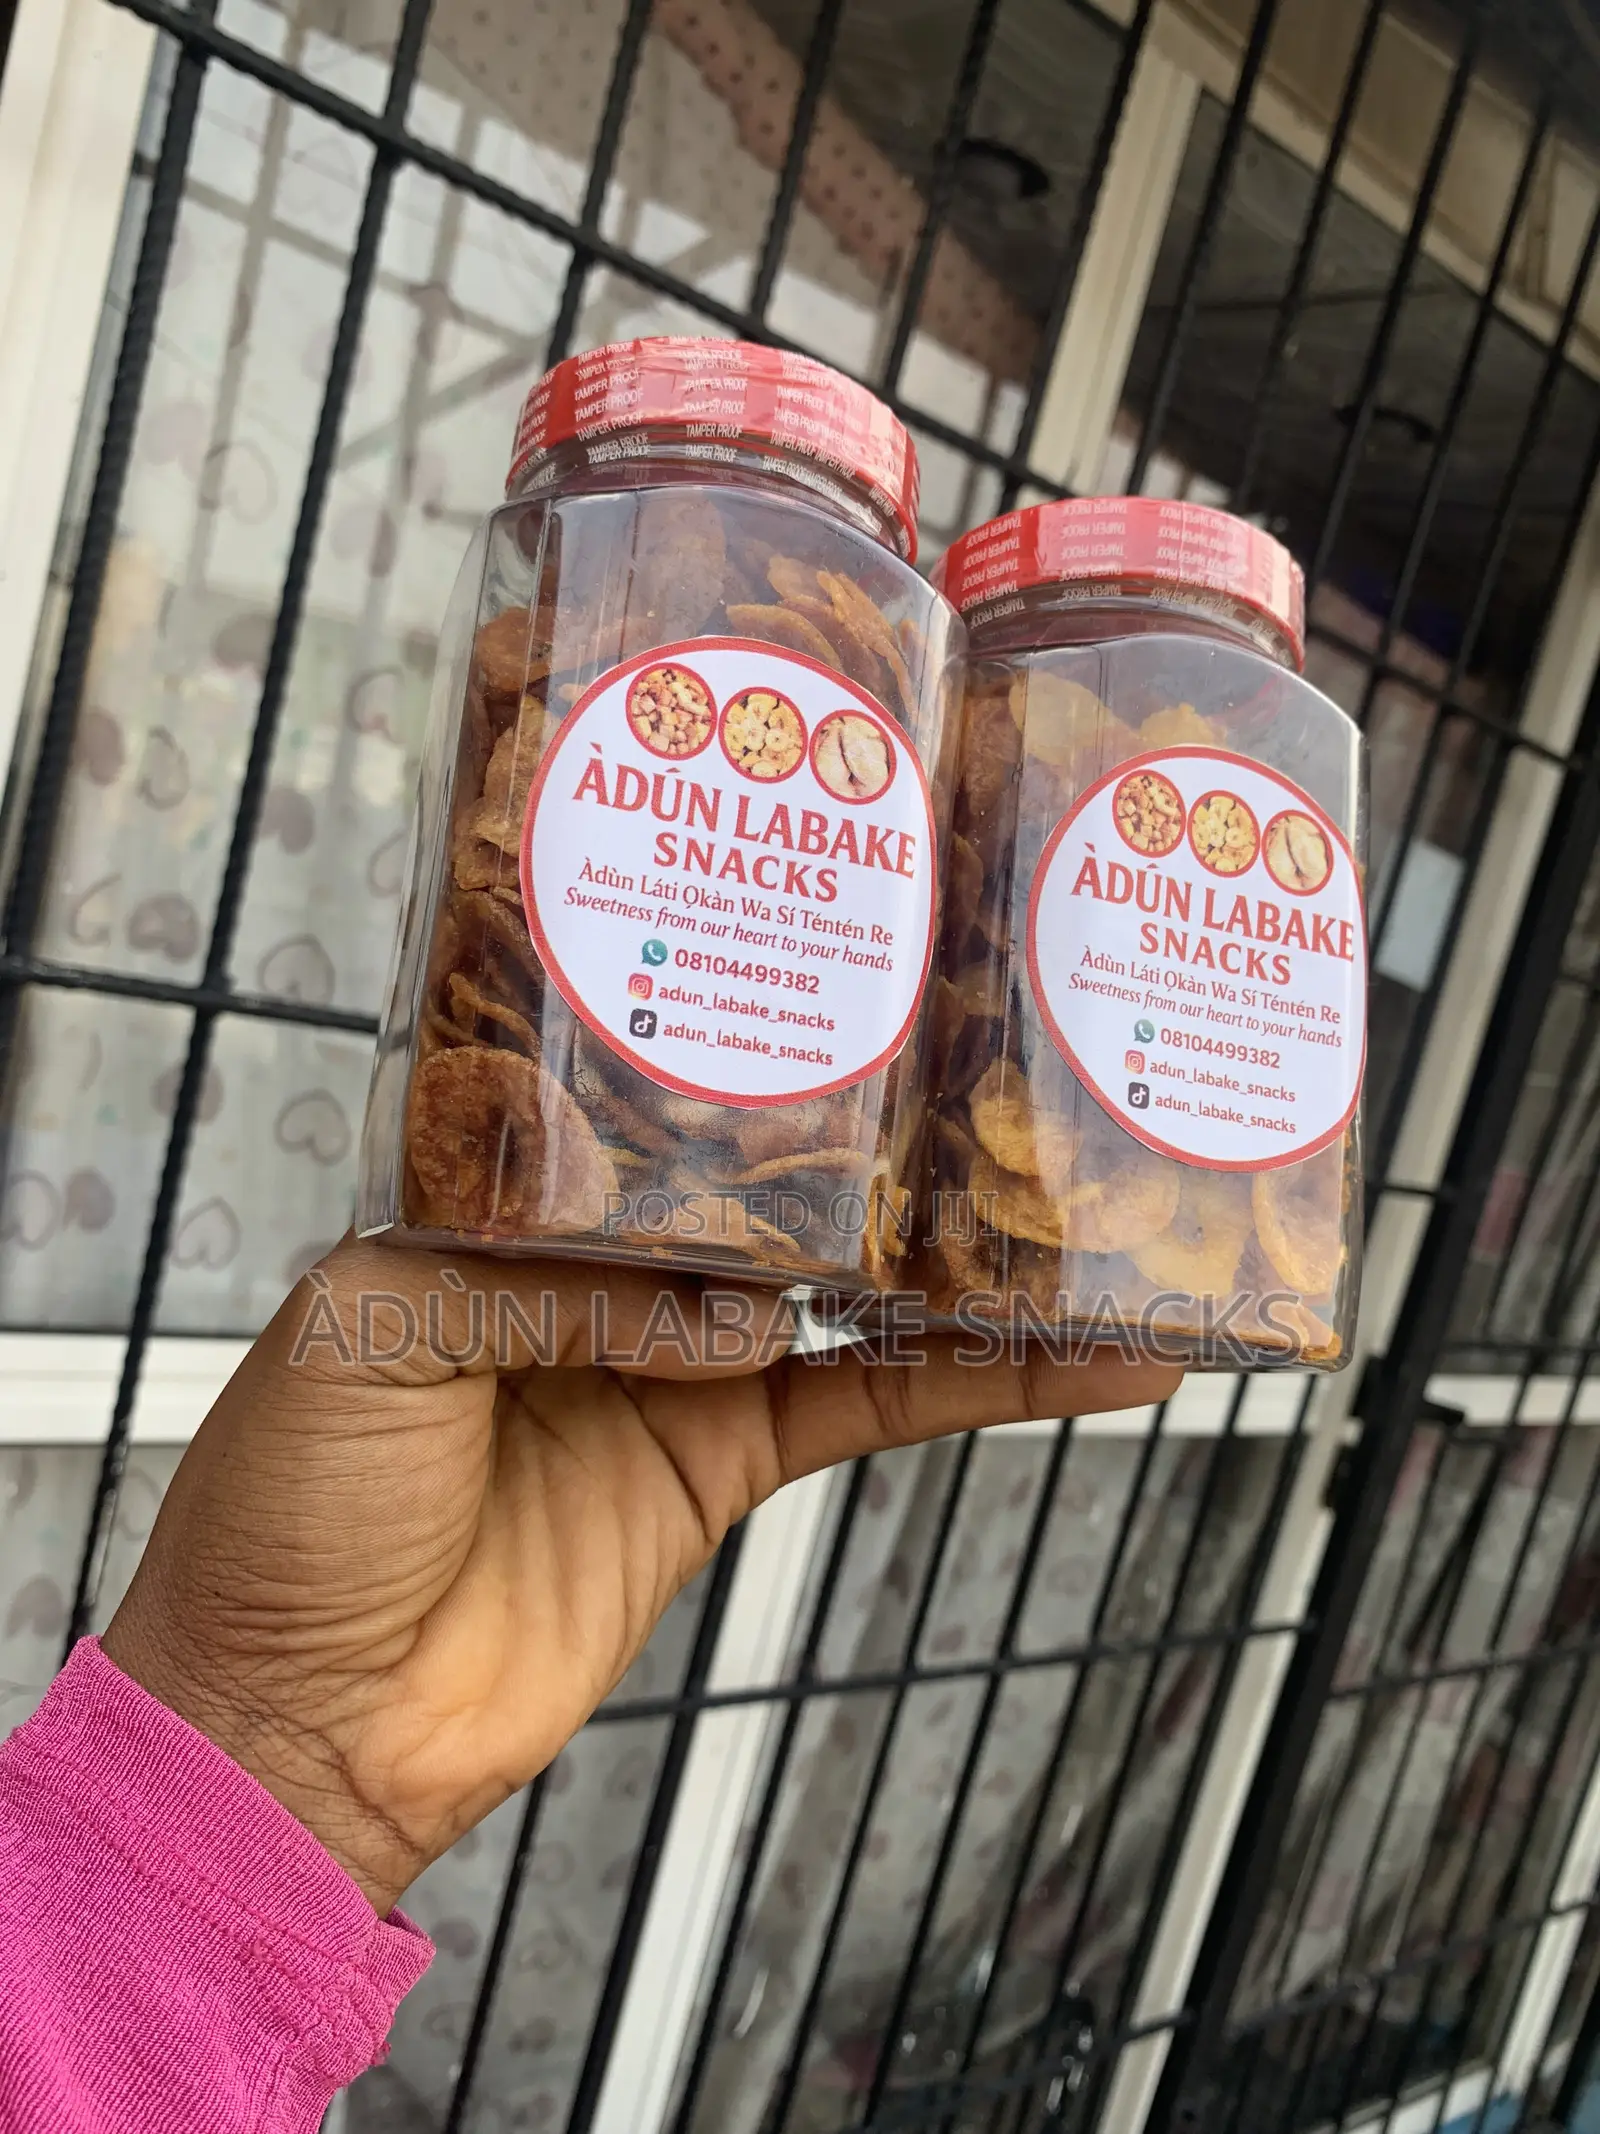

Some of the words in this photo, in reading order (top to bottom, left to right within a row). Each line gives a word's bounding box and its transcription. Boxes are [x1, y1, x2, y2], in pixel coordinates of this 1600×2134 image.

[575, 380, 608, 401] TAMPER
[609, 368, 640, 389] PROOF
[575, 401, 608, 422] TAMPER
[610, 389, 644, 409] PROOF
[576, 420, 611, 442] TAMPER
[612, 412, 645, 431] PROOF
[686, 424, 717, 438] TAMPER
[717, 425, 743, 439] PROOF
[685, 444, 715, 459] TAMPER
[714, 448, 738, 463] PROOF
[770, 429, 796, 450] TAMPER
[795, 435, 817, 458] PROOF
[966, 528, 989, 549] PROOF
[990, 516, 1022, 534] TAMPER
[963, 548, 987, 570] PROOF
[988, 536, 1020, 558] TAMPER
[962, 570, 985, 592] PROOF
[987, 558, 1019, 580] TAMPER
[961, 593, 984, 613] PROOF
[985, 580, 1019, 601] TAMPER
[1061, 587, 1091, 602] PROOF
[1091, 584, 1122, 596] TAMPER
[970, 607, 993, 630] PROOF
[994, 597, 1026, 616] TAMPER
[733, 794, 917, 880] LABAKE
[653, 833, 839, 903] SNACKS
[578, 856, 635, 892] Àdùn
[640, 872, 678, 902] Láti
[741, 896, 772, 922] Wa
[776, 905, 797, 927] Sí
[800, 909, 865, 941] Téntén
[870, 924, 894, 947] Re
[563, 886, 654, 923] Sweetness
[655, 905, 697, 934] from
[700, 921, 732, 939] our
[733, 922, 778, 950] heart
[781, 935, 799, 953] to
[798, 940, 840, 961] your
[842, 944, 894, 973] hands
[1202, 888, 1355, 964] LABAKE
[1139, 922, 1292, 986] SNACKS
[674, 948, 821, 995] 08104499382
[1080, 945, 1126, 978] Àdùn
[1130, 960, 1161, 986] Láti
[1211, 981, 1237, 1003] Wa
[1241, 988, 1258, 1007] Sí
[1261, 992, 1316, 1020] Téntén
[1320, 1004, 1341, 1025] Re
[657, 984, 836, 1031] adun_labake_snacks
[1068, 972, 1142, 1005] Sweetness
[1144, 989, 1177, 1017] from
[1180, 1002, 1205, 1020] our
[1206, 1004, 1244, 1028] heart
[1246, 1016, 1260, 1031] to
[1260, 1021, 1296, 1039] your
[1298, 1023, 1343, 1049] hands
[663, 1022, 834, 1067] adun_labake_snacks
[1160, 1027, 1281, 1070] 08104499382
[1150, 1060, 1296, 1103] adun_labake_snacks
[1155, 1093, 1298, 1136] adun_labake_snacks
